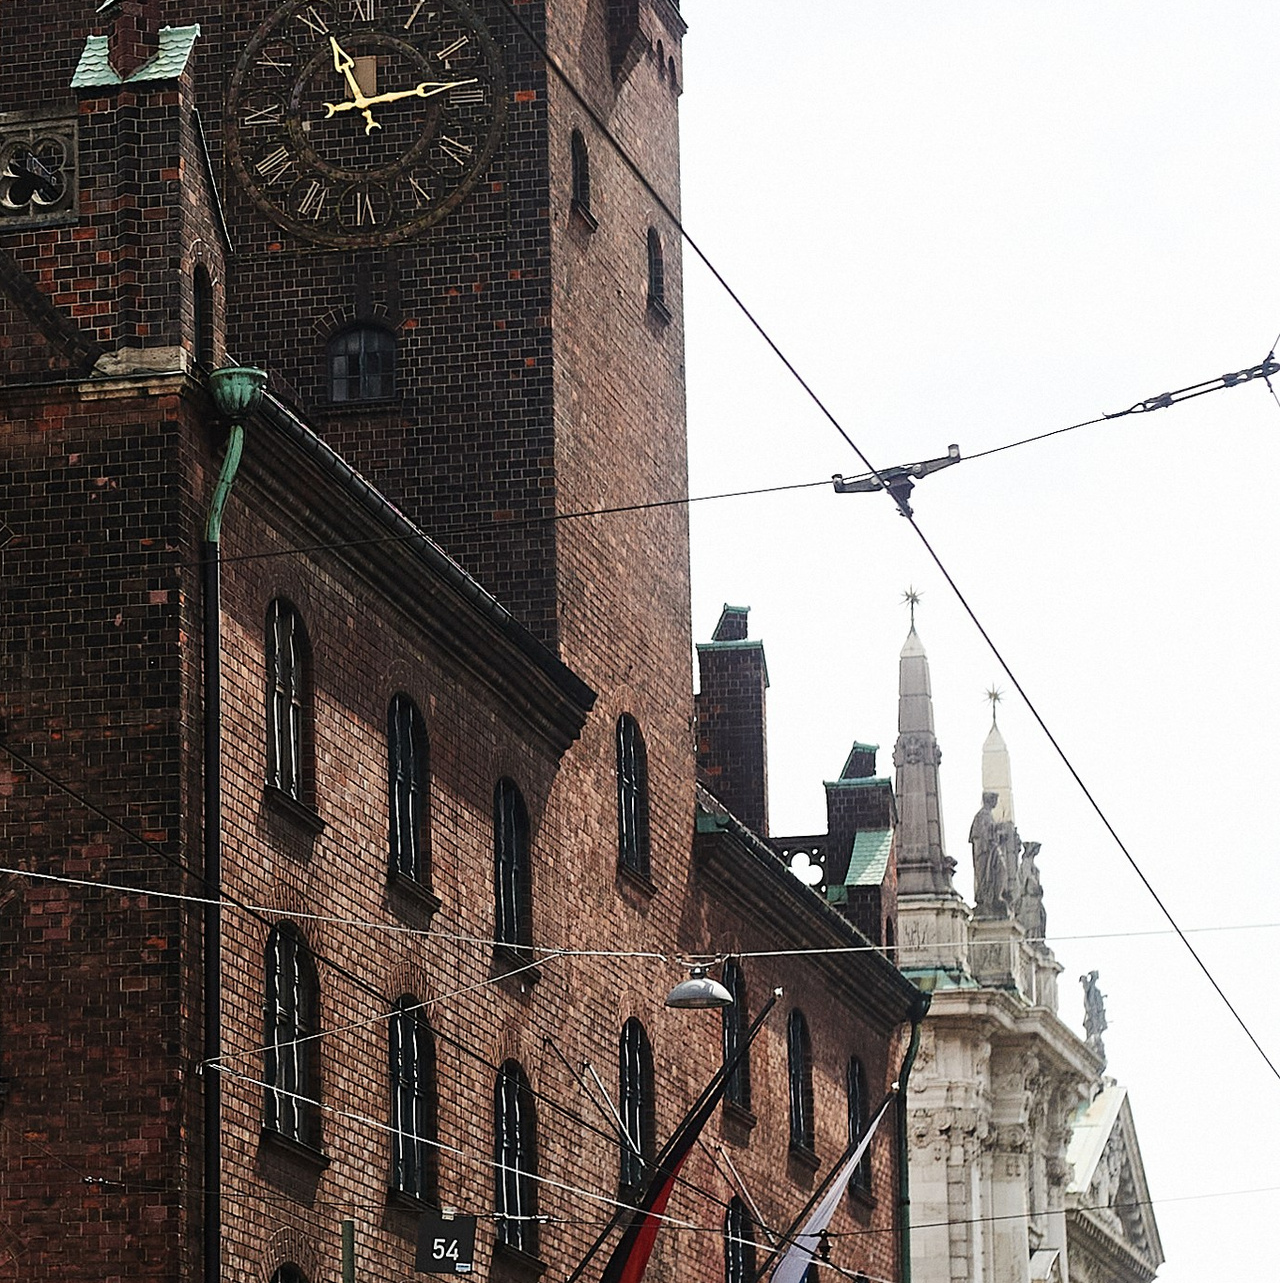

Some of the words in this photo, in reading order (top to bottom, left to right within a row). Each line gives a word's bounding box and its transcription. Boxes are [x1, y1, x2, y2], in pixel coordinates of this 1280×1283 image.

[297, 6, 330, 42] XI
[256, 51, 292, 77] X
[450, 90, 484, 104] III
[242, 105, 280, 125] IX
[256, 146, 293, 186] VIII
[297, 181, 329, 220] VII
[356, 192, 376, 226] VI
[432, 1238, 459, 1261] 54
